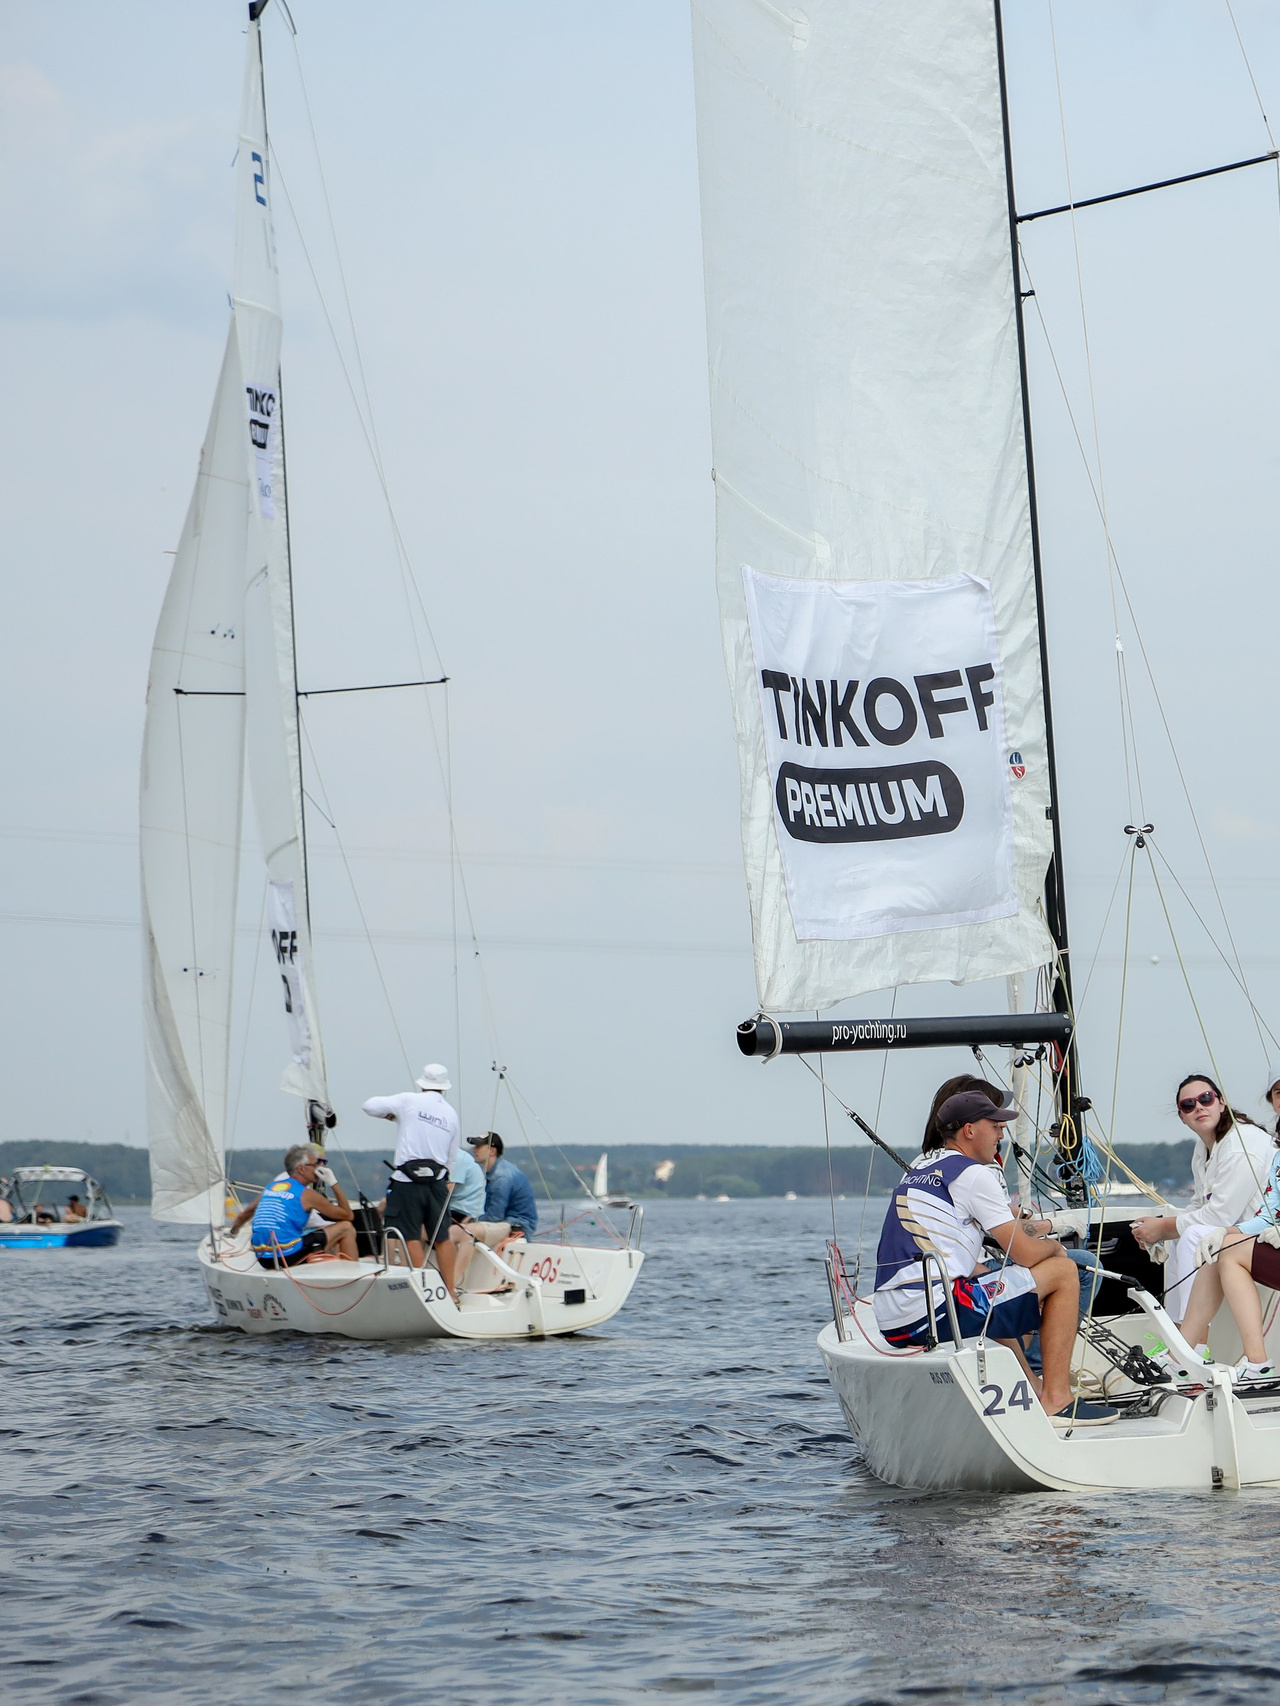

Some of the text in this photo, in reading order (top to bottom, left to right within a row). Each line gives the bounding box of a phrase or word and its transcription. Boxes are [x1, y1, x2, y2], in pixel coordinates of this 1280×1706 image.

[762, 662, 995, 748] TINKOFF
[785, 774, 949, 828] PREMIUM
[832, 1020, 907, 1045] pro-yachting.ru
[423, 1286, 447, 1303] 20
[979, 1380, 1034, 1416] 24
